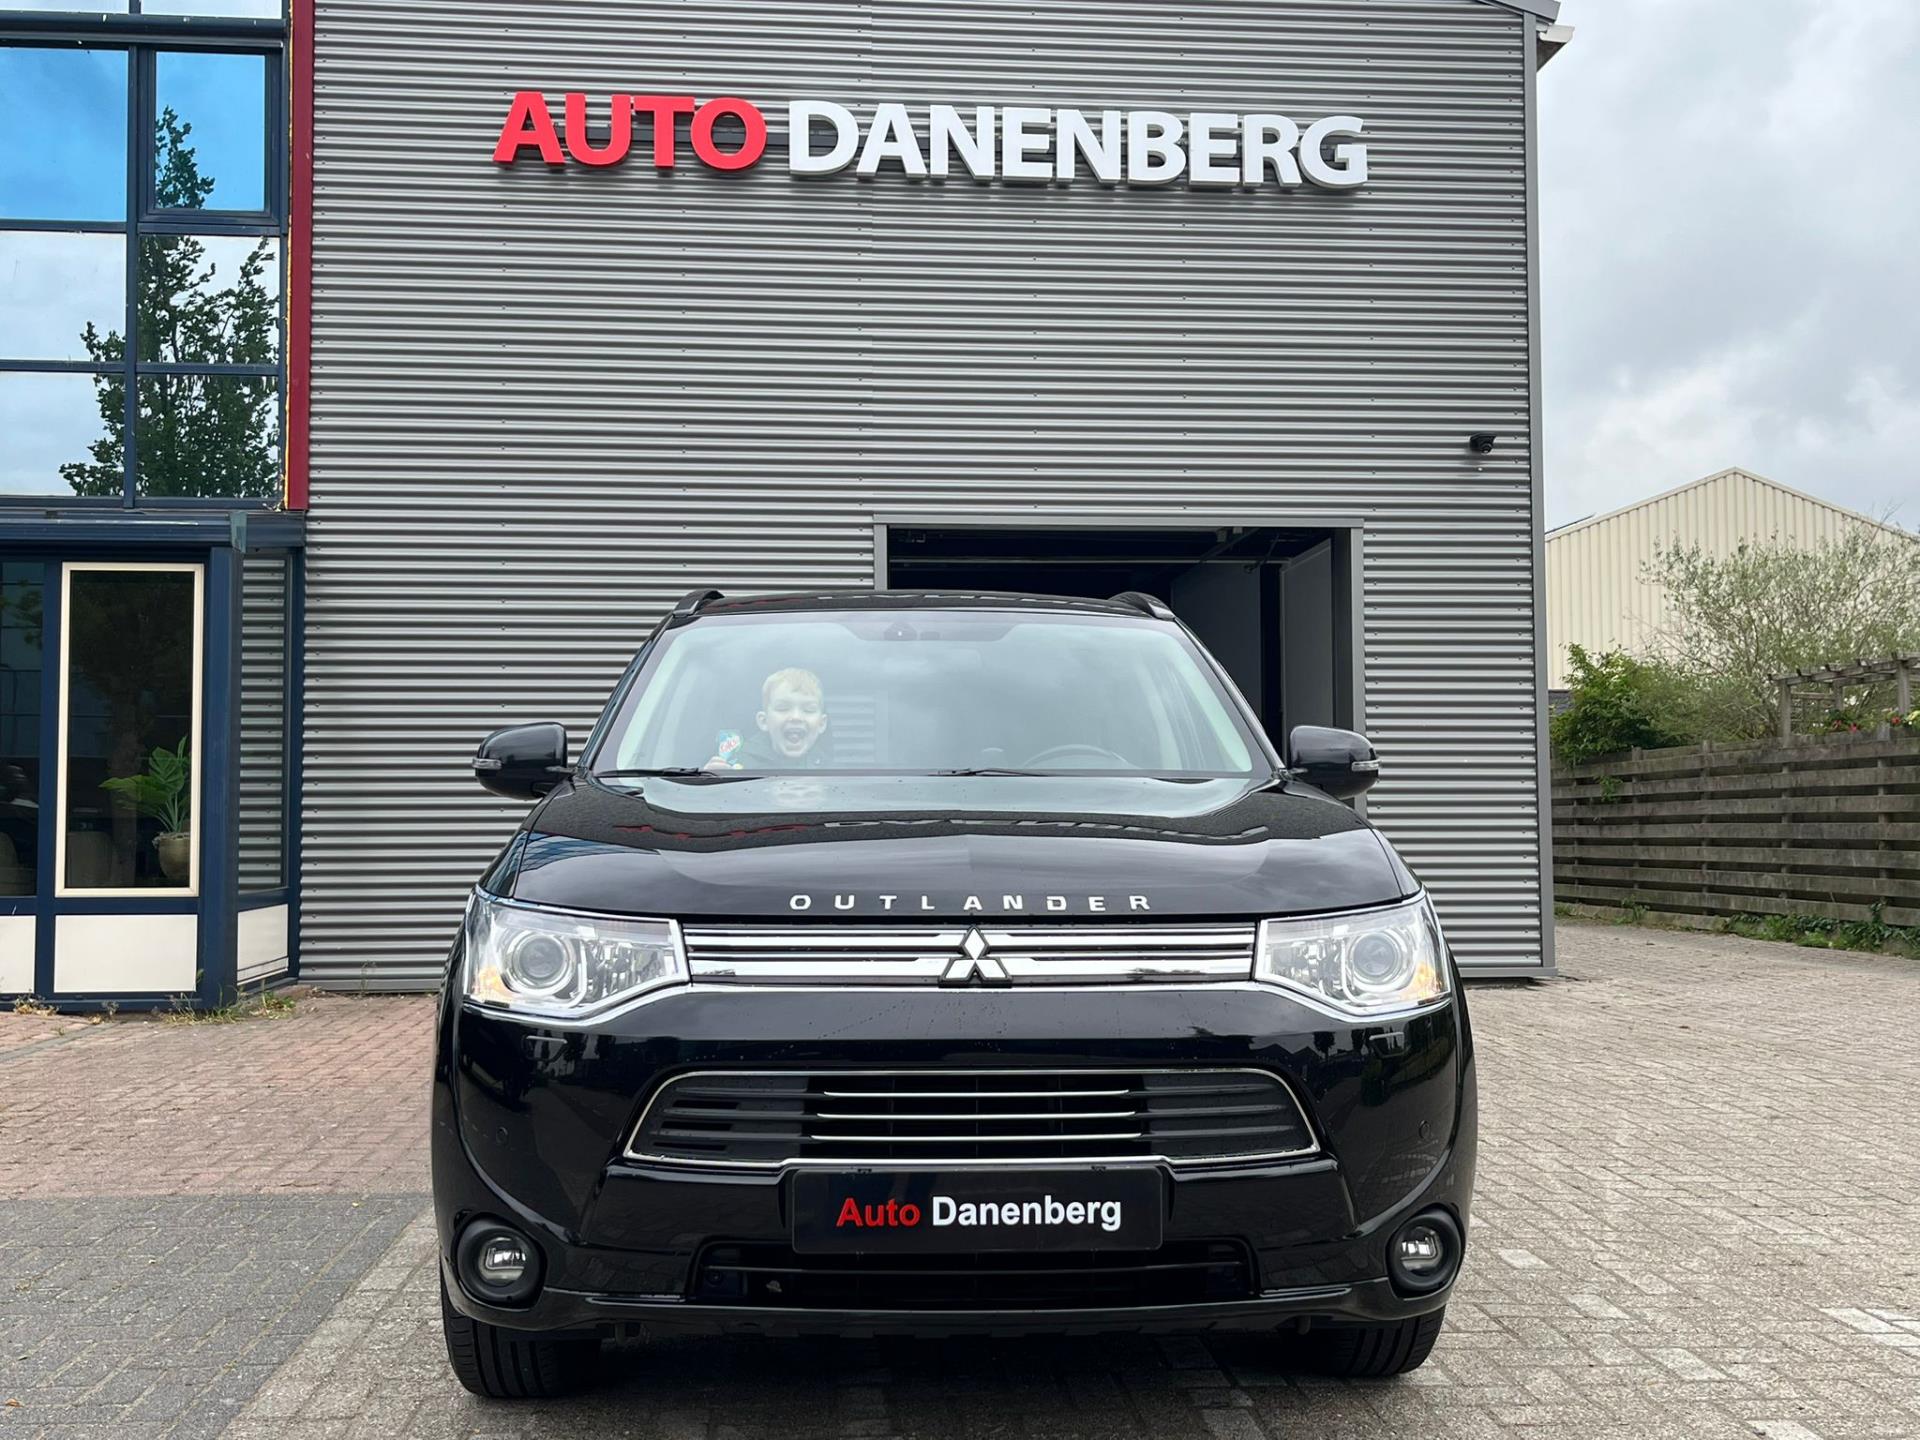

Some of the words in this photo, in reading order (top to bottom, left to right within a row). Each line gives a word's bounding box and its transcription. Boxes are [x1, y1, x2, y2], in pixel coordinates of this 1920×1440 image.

[493, 90, 768, 172] AUTO
[788, 99, 1369, 188] DANENBERG
[789, 894, 1151, 911] OUTLANDER
[836, 1197, 921, 1227] Auto
[932, 1195, 1122, 1232] Danenberg
